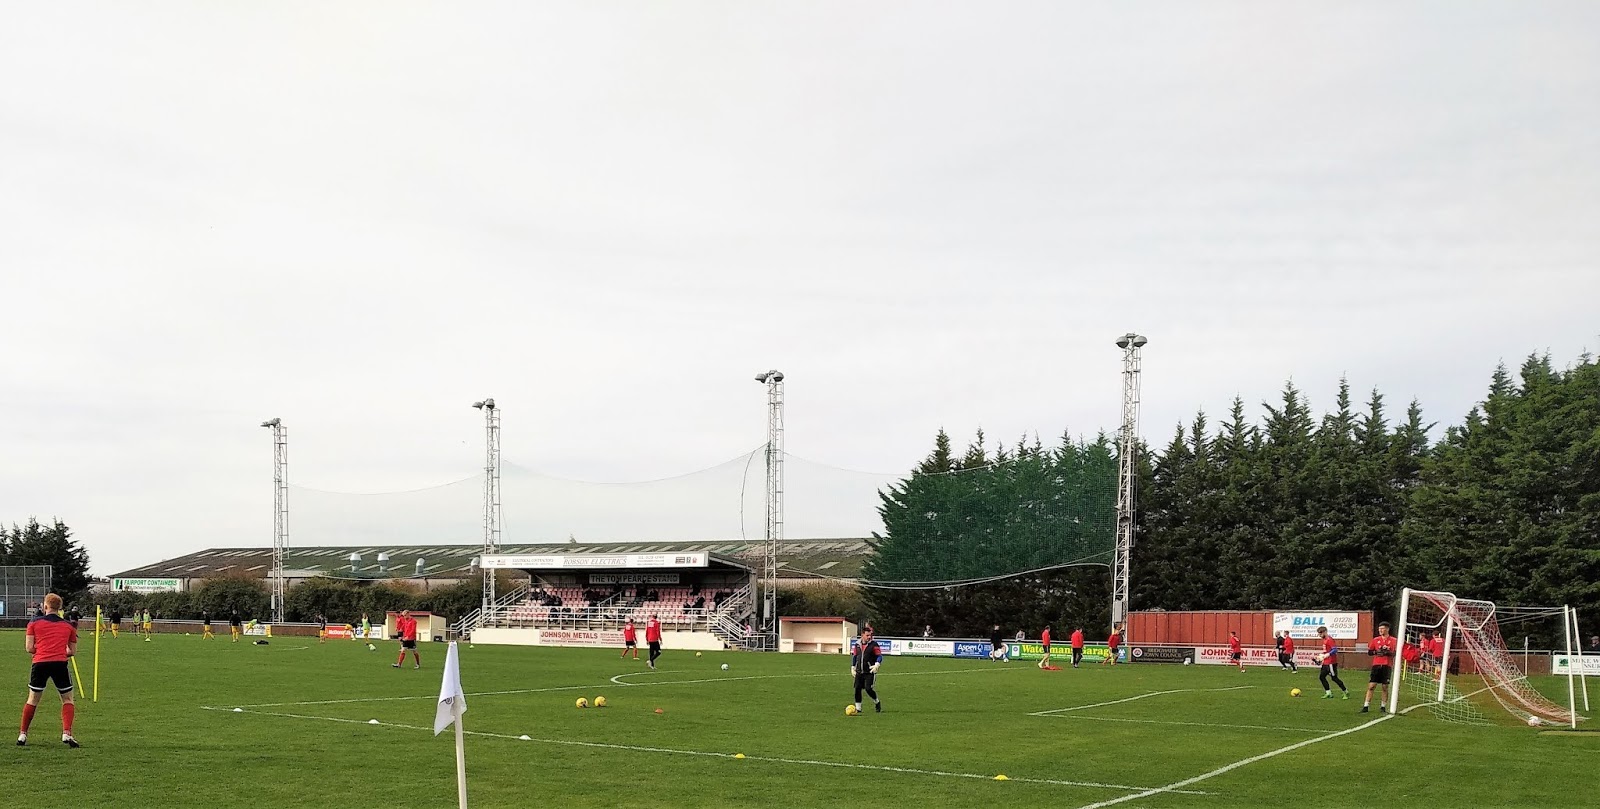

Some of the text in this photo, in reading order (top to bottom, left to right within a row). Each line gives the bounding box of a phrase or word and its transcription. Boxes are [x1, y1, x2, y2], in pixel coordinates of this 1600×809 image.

[1293, 616, 1326, 625] BALL
[958, 644, 976, 652] Aspen
[1022, 644, 1110, 656] Wateman Garag
